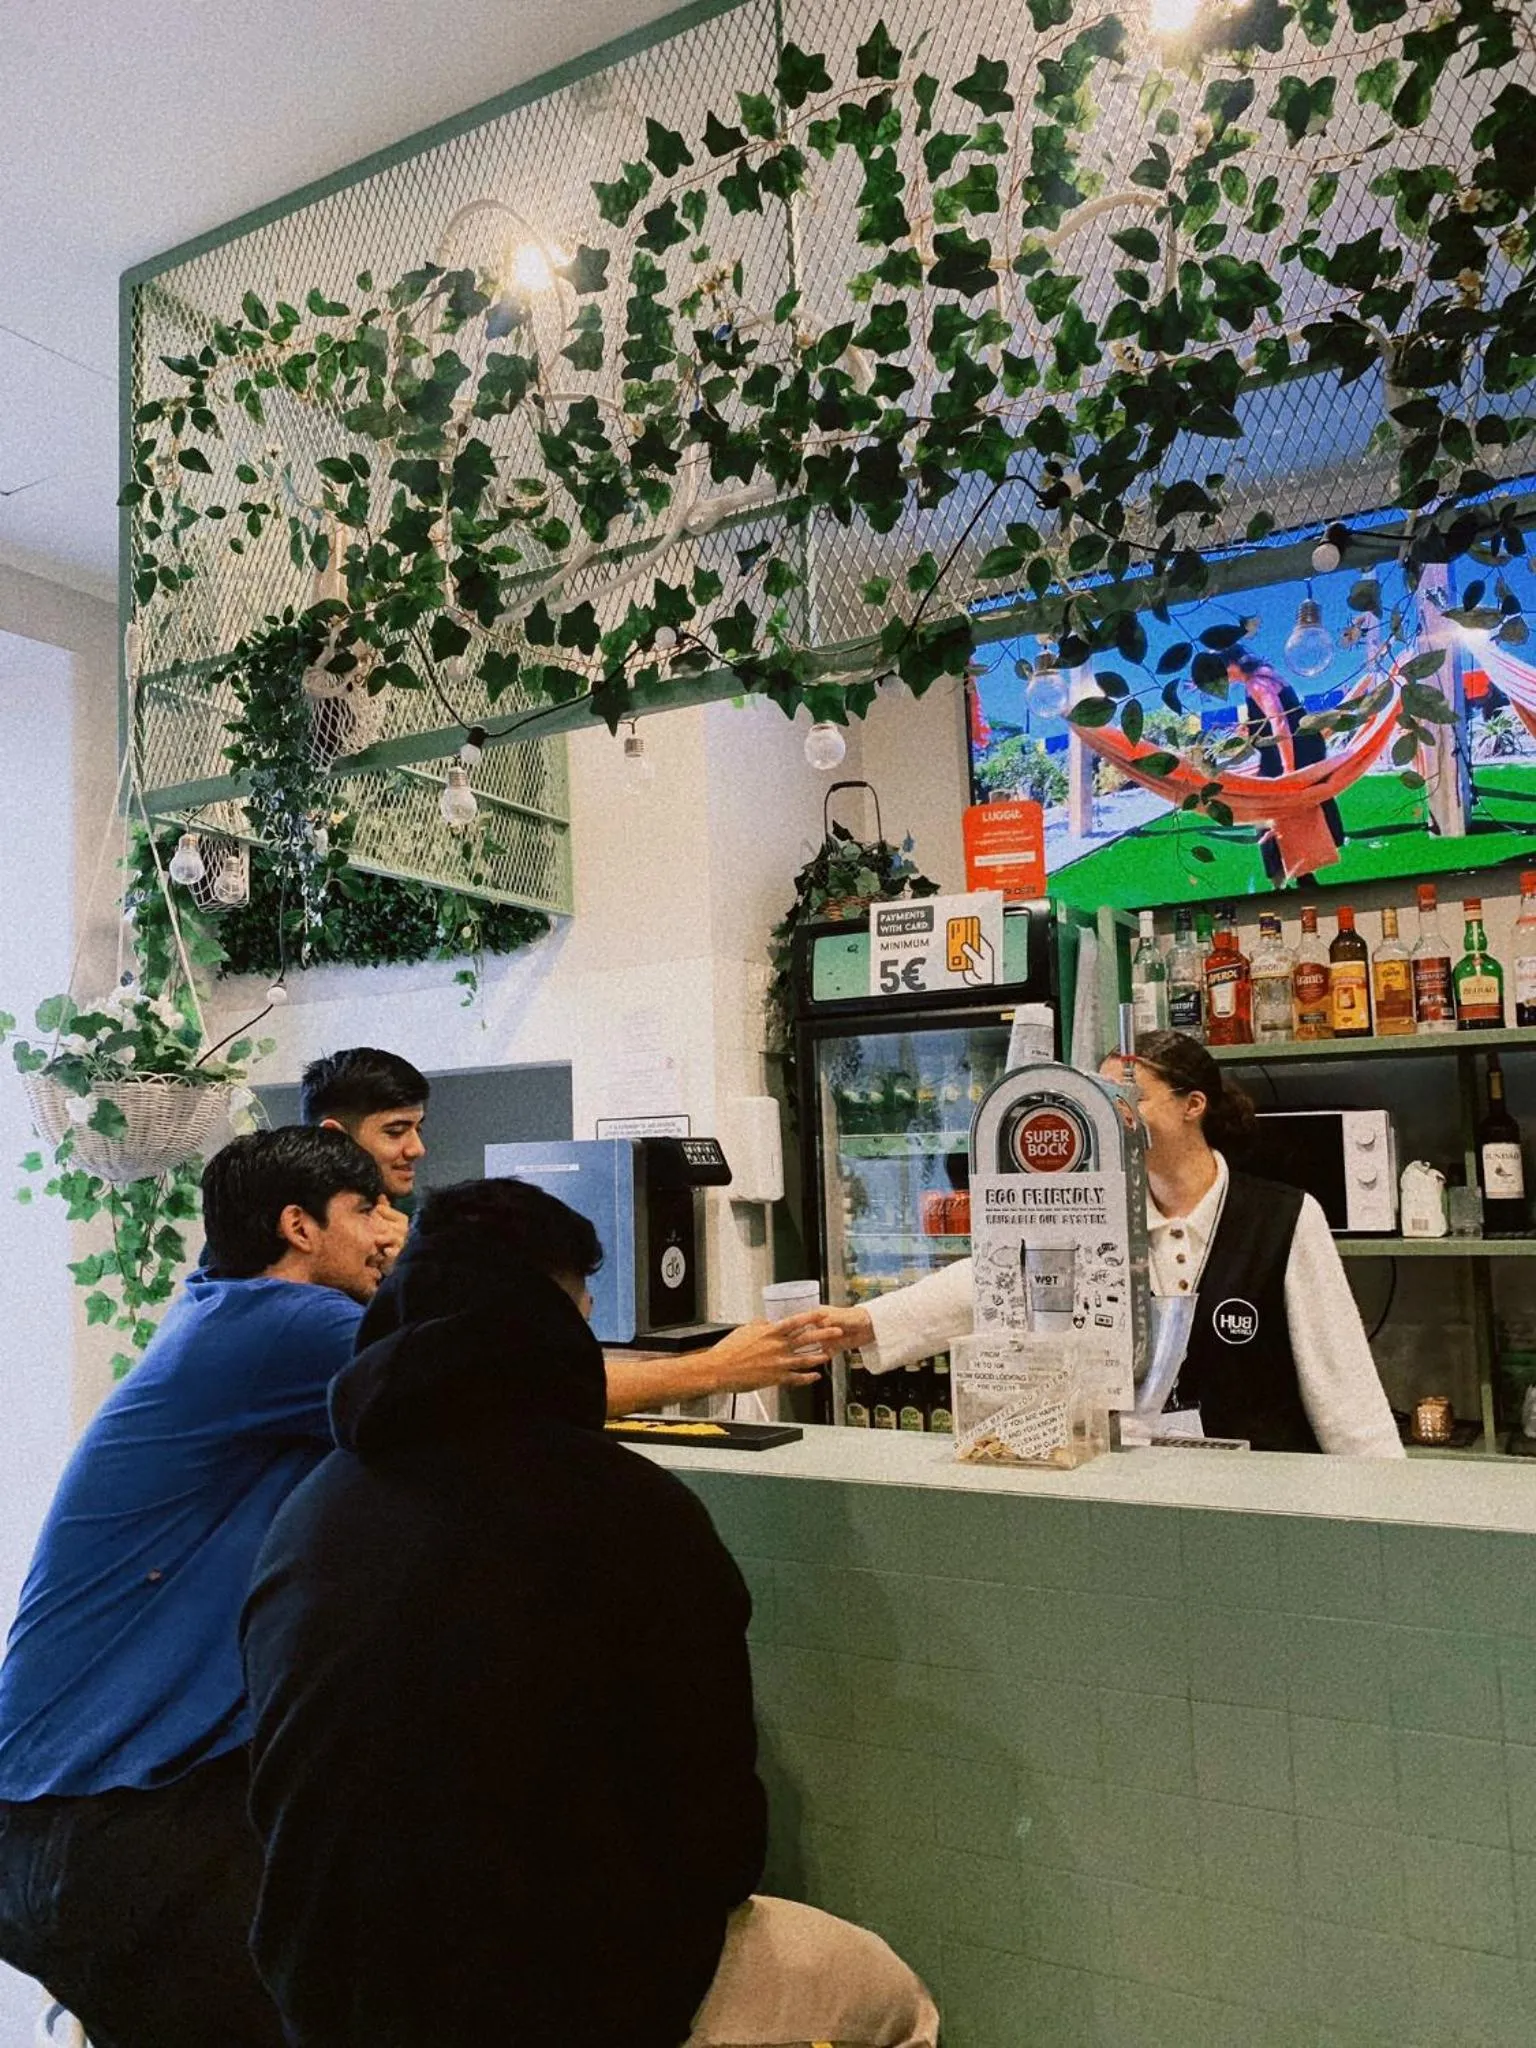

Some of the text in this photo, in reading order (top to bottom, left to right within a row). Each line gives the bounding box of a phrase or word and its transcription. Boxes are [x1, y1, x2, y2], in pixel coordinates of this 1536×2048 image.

[879, 910, 926, 923] PAYMENTS
[880, 924, 903, 934] WITH
[879, 938, 930, 952] MINIMUM
[879, 957, 927, 994] 5€
[1025, 1128, 1070, 1144] SUPER
[1027, 1142, 1068, 1157] BOCK
[985, 1187, 1105, 1205] ECO FRIENDLY
[985, 1215, 1037, 1225] REUSABLE
[1061, 1214, 1107, 1225] SYSTEM
[1220, 1314, 1253, 1330] HUB
[995, 1374, 1027, 1382] LOOKING
[1010, 1417, 1024, 1427] YOU
[1025, 1412, 1038, 1422] ARE
[1038, 1404, 1062, 1417] HAPPY
[1008, 1430, 1022, 1440] AND
[1023, 1425, 1037, 1435] YOU
